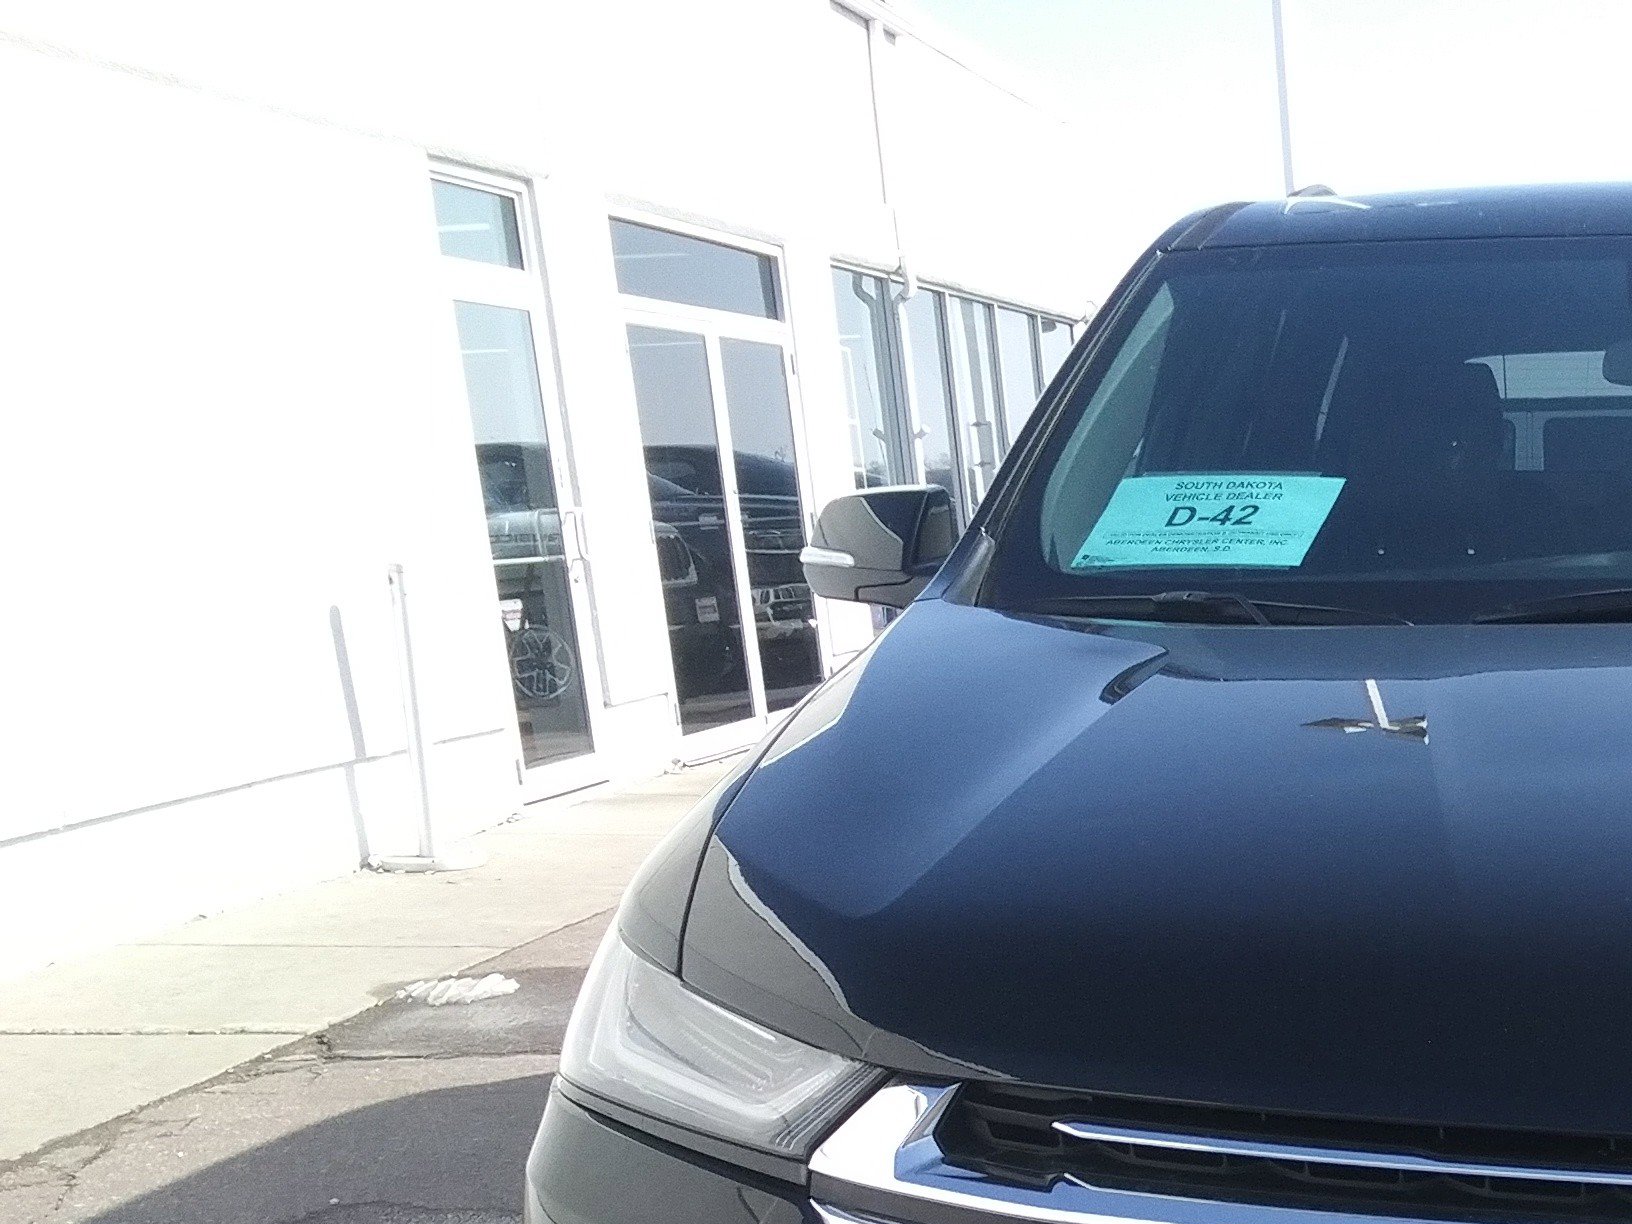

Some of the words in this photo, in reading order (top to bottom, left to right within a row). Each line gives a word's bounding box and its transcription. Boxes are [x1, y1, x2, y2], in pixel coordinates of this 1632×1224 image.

[1174, 481, 1223, 491] SOUTH
[1226, 481, 1283, 491] DAKOTA
[1164, 493, 1225, 502] VEHICLE
[1226, 492, 1283, 501] DEALER
[1164, 504, 1260, 527] D-42
